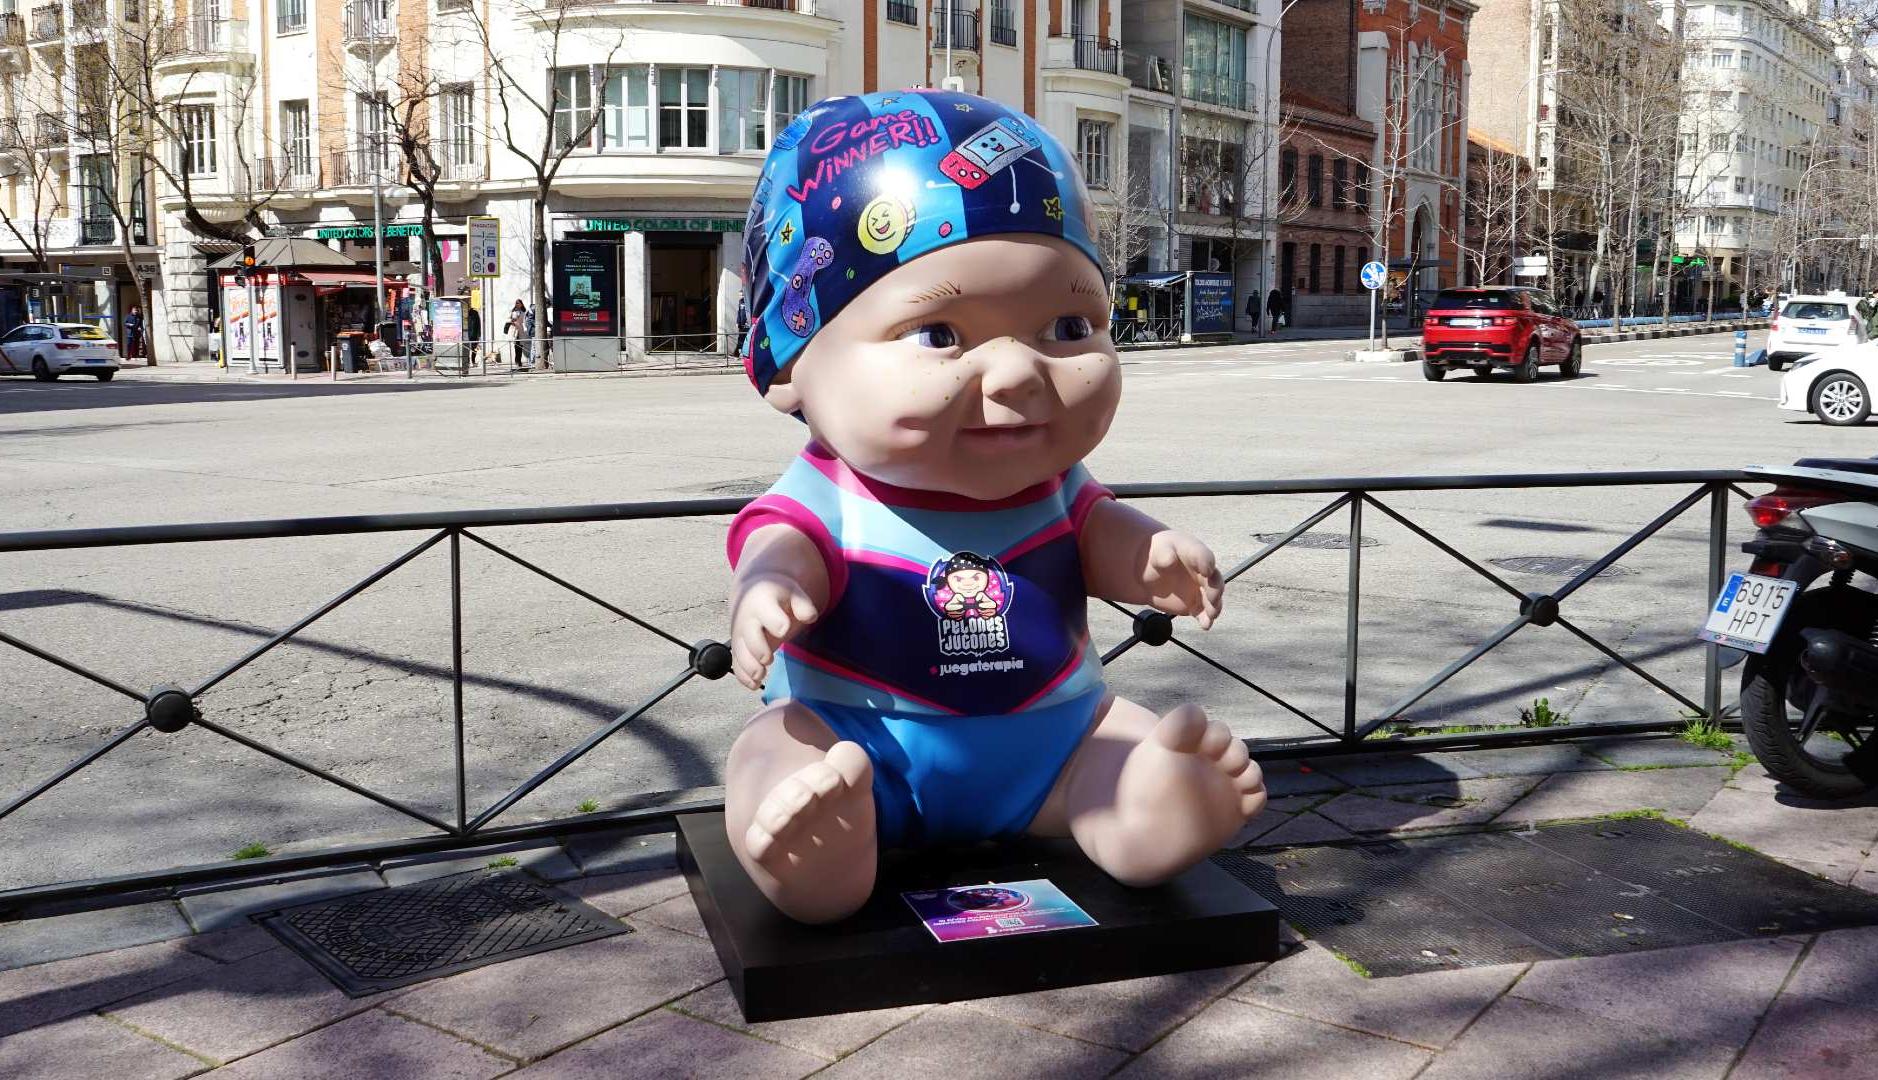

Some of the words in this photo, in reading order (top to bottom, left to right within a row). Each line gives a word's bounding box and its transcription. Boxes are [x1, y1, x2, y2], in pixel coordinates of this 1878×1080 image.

[811, 110, 917, 154] Game
[586, 219, 630, 231] UNITED
[1735, 580, 1790, 610] 6915
[1727, 608, 1771, 638] HPT
[939, 656, 1024, 677] juegaterapia
